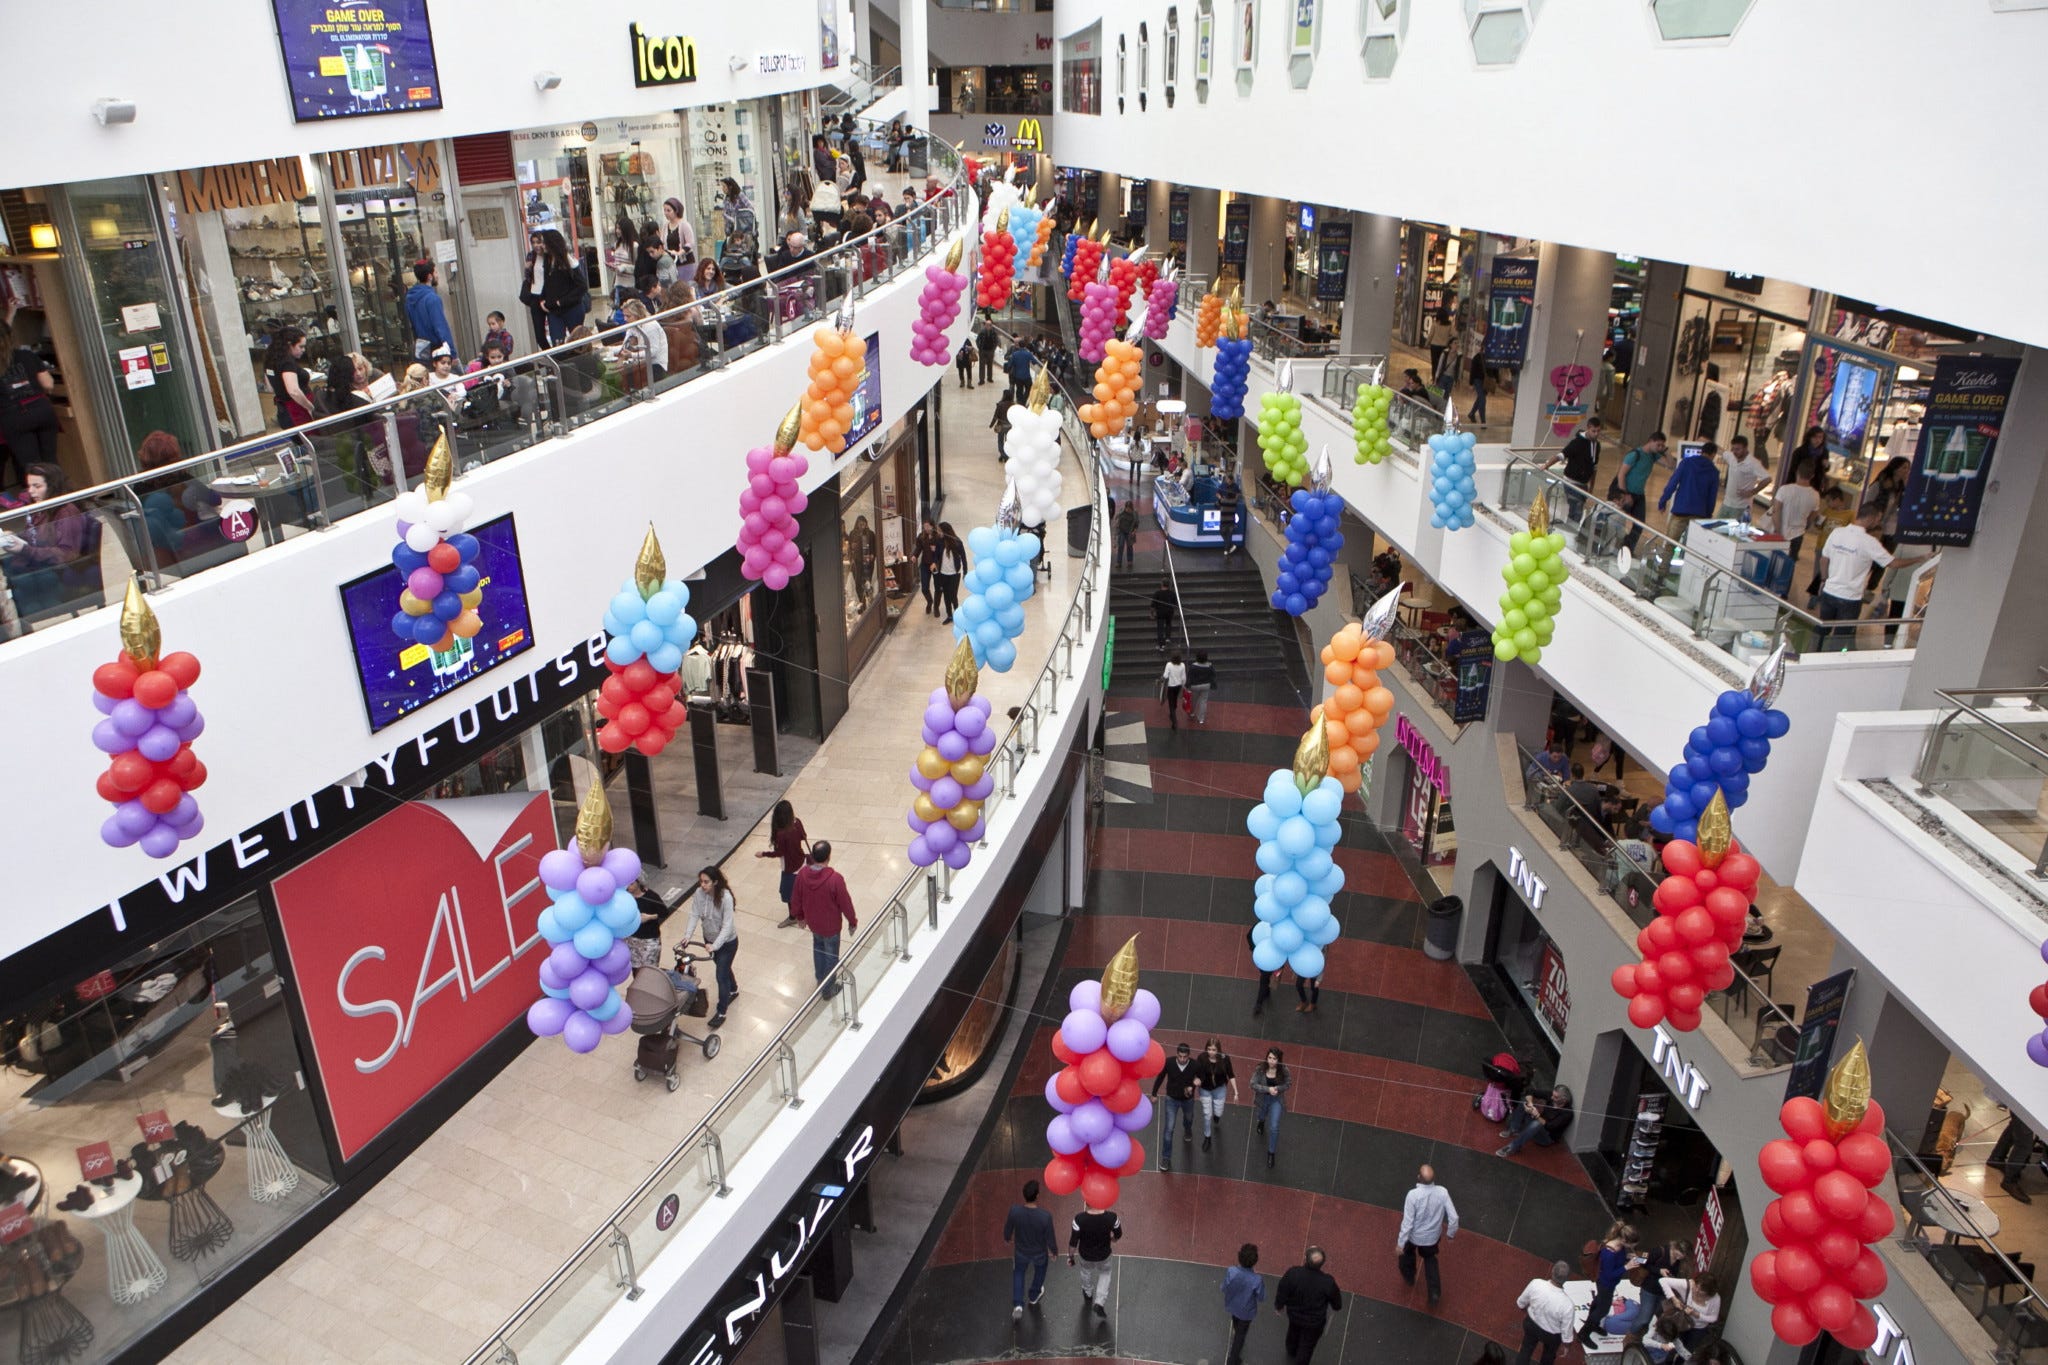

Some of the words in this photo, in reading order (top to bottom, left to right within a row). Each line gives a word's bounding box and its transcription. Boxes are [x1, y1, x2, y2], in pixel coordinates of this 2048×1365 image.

[326, 9, 357, 22] GAME
[358, 9, 385, 22] OVER
[636, 22, 697, 81] icon
[760, 55, 787, 73] FULLSPOT
[178, 155, 307, 214] MORENO
[1935, 393, 1970, 404] GAME
[1972, 394, 2005, 405] OVER
[1950, 371, 1998, 388] Kiehl's
[231, 510, 247, 532] A
[1395, 713, 1447, 797] INTIMA
[1509, 846, 1548, 909] TNT
[337, 832, 545, 1073] SALE
[1652, 1024, 1710, 1109] TNT
[1706, 1191, 1722, 1238] SALE
